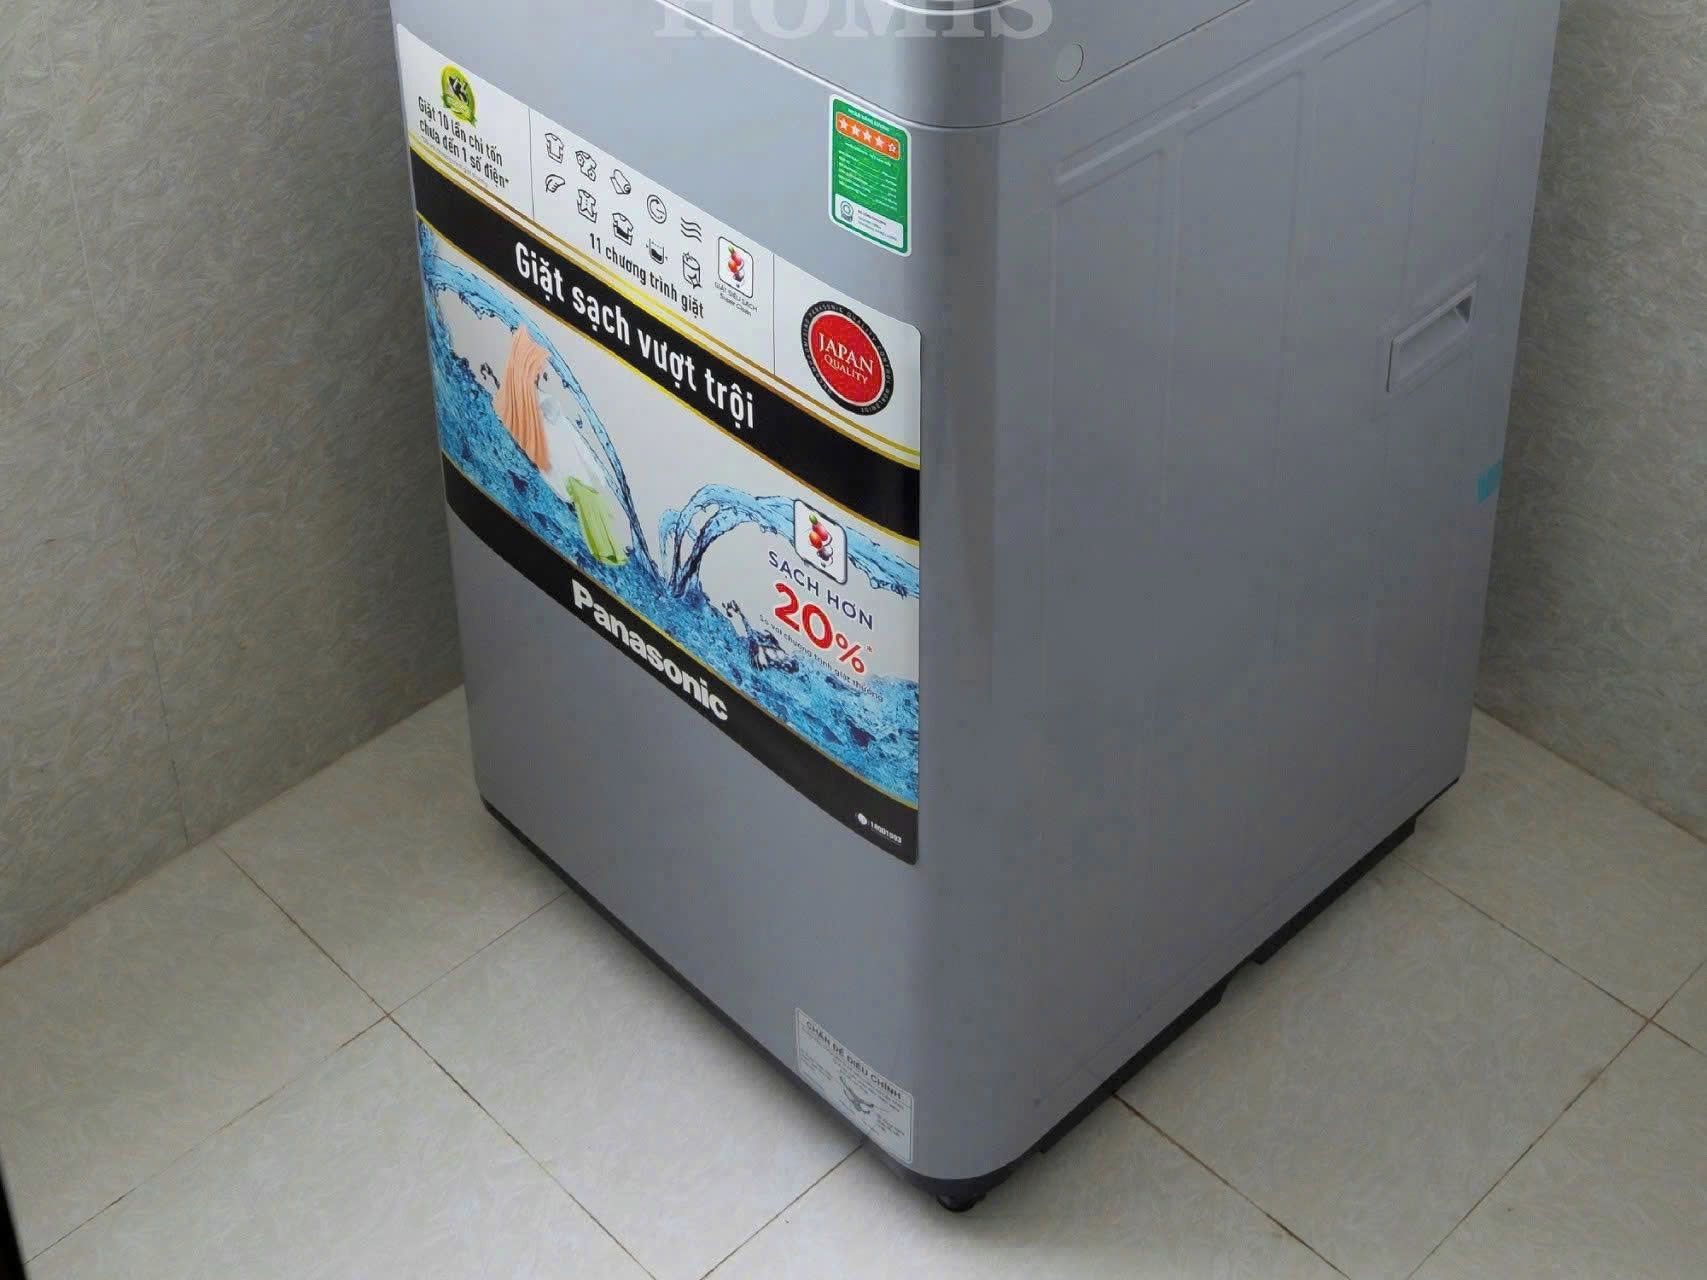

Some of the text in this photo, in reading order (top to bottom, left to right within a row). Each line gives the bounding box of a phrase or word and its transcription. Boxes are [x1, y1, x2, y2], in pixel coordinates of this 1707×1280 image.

[418, 96, 436, 123] Giặt
[438, 111, 449, 131] 10
[451, 119, 467, 143] lần
[486, 143, 503, 167] tốn
[442, 134, 460, 159] đến
[462, 146, 468, 162] 1
[470, 155, 482, 172] số
[589, 232, 705, 320] 11 chương trình giặt
[515, 241, 754, 430] Giặt sạch vượt trội
[819, 332, 874, 375] JAPAN
[824, 354, 868, 384] QUALITY
[768, 550, 873, 630] SẠCH HƠN
[571, 578, 729, 721] Panasonic
